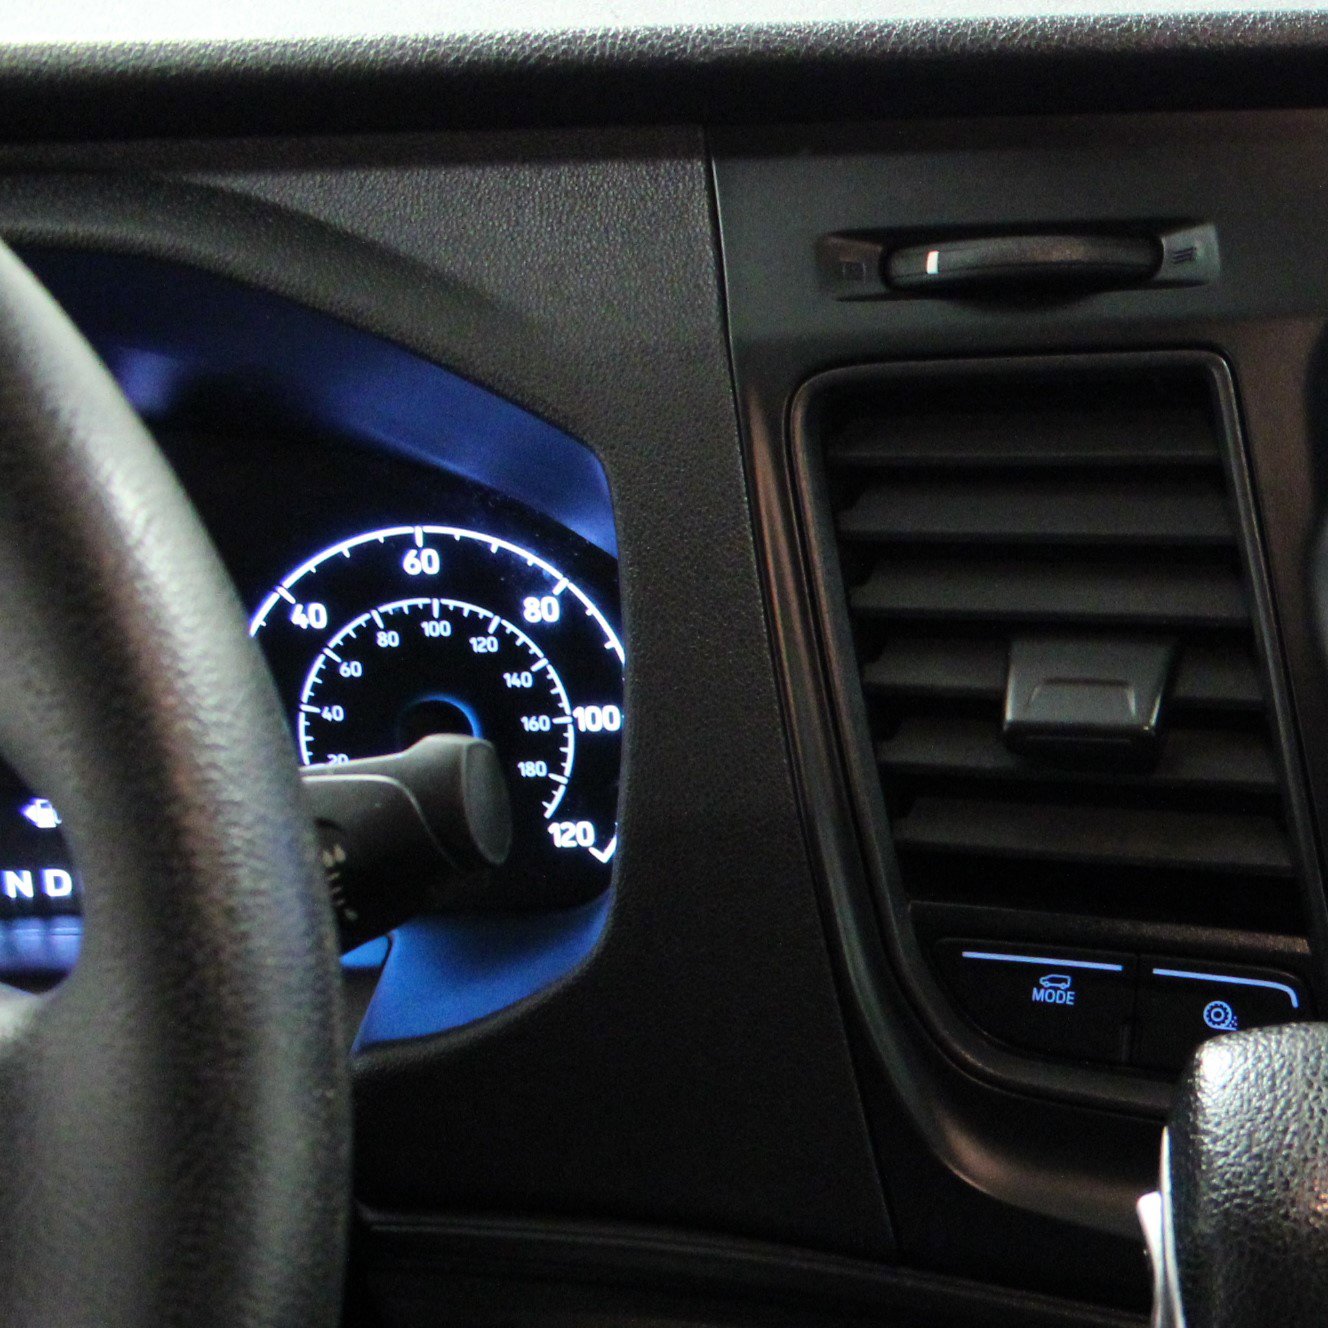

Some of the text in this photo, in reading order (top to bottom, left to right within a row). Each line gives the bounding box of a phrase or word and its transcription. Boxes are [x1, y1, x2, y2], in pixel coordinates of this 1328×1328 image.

[402, 548, 441, 576] 60
[290, 602, 328, 630] 40
[522, 597, 561, 623] 80
[420, 619, 452, 638] 100
[375, 630, 400, 648] 80
[470, 635, 499, 654] 120
[338, 660, 363, 678] 60
[503, 671, 533, 689] 140
[320, 704, 345, 722] 40
[572, 704, 621, 733] 100
[520, 714, 551, 732] 160
[517, 760, 547, 777] 180
[548, 820, 596, 848] 120
[1032, 987, 1075, 1005] MODE
